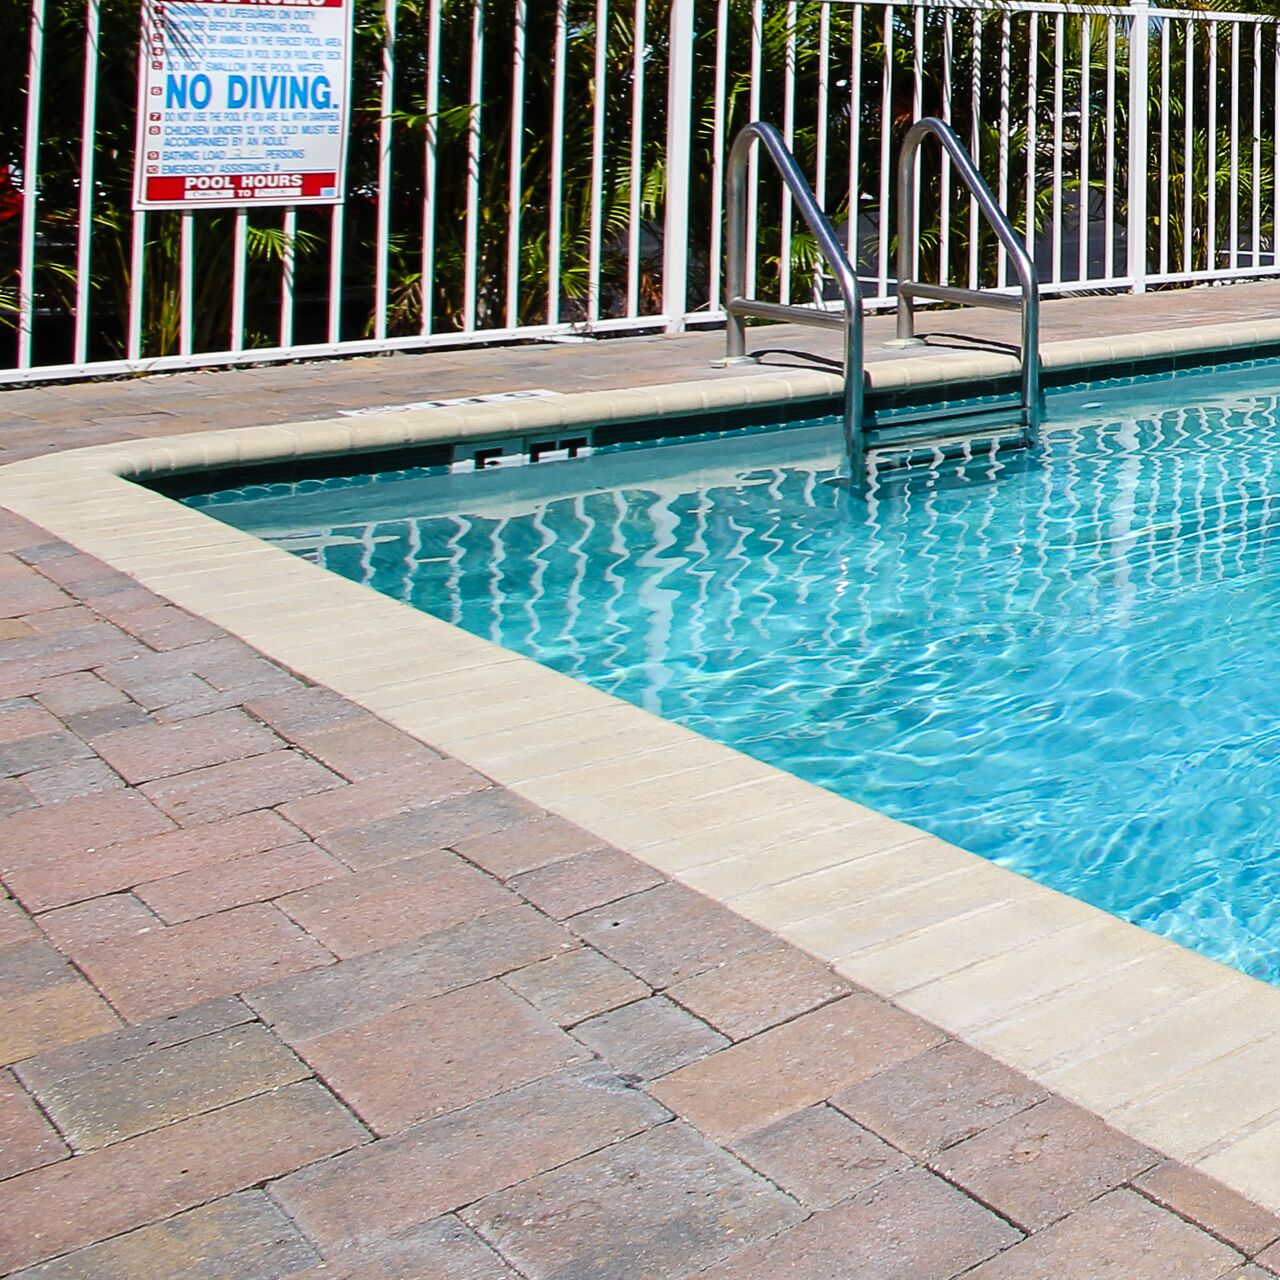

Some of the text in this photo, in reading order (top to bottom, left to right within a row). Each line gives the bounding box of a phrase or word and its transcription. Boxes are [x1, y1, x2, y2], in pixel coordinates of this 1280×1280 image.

[214, 8, 226, 17] NO
[209, 21, 242, 32] BEFORE
[246, 22, 287, 33] ENTERING
[251, 63, 267, 72] THE
[270, 63, 292, 72] POOL
[166, 74, 212, 110] NO
[227, 75, 339, 110] DIVING.
[164, 126, 209, 135] CHILDREN
[213, 126, 242, 135] UNDER
[281, 125, 299, 135] OLD
[301, 125, 325, 134] MUST
[328, 125, 339, 134] BE
[164, 136, 229, 147] ACCOMPANIED
[232, 136, 243, 146] BY
[247, 136, 259, 146] AN
[162, 150, 200, 161] BATHING
[203, 150, 226, 160] LOAD
[162, 164, 216, 174] EMERGENCY
[219, 163, 271, 173] ASSISTANCE
[184, 174, 303, 189] POOL HOURS
[237, 189, 252, 198] TO
[529, 437, 588, 464] FT
